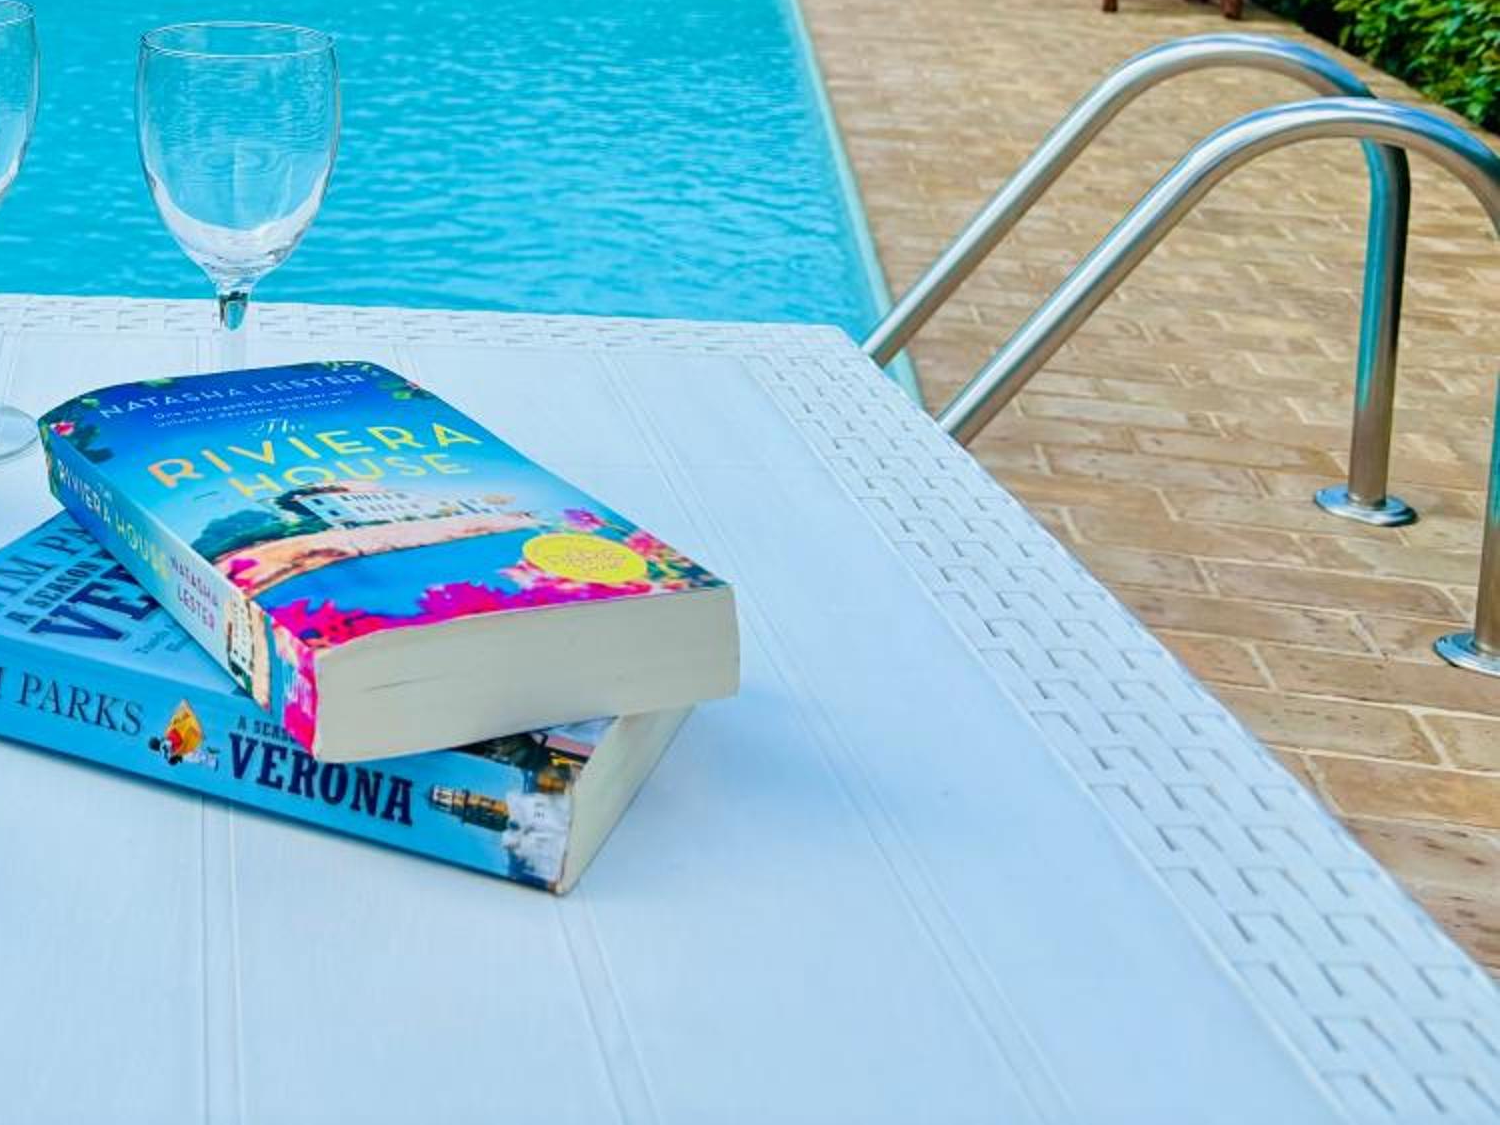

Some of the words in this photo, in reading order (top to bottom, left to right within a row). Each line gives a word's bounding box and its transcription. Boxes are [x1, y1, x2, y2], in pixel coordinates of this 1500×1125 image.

[100, 388, 248, 419] NATASHA
[252, 373, 365, 394] LESTER
[147, 421, 483, 489] RIVIERA
[228, 452, 470, 498] HOUSE
[57, 458, 112, 524] RIVIERA
[115, 510, 171, 581] HOUSE
[169, 554, 219, 607] NATASHA
[177, 583, 215, 631] LESTER
[15, 670, 146, 737] PARKS
[228, 731, 414, 827] VERONA
